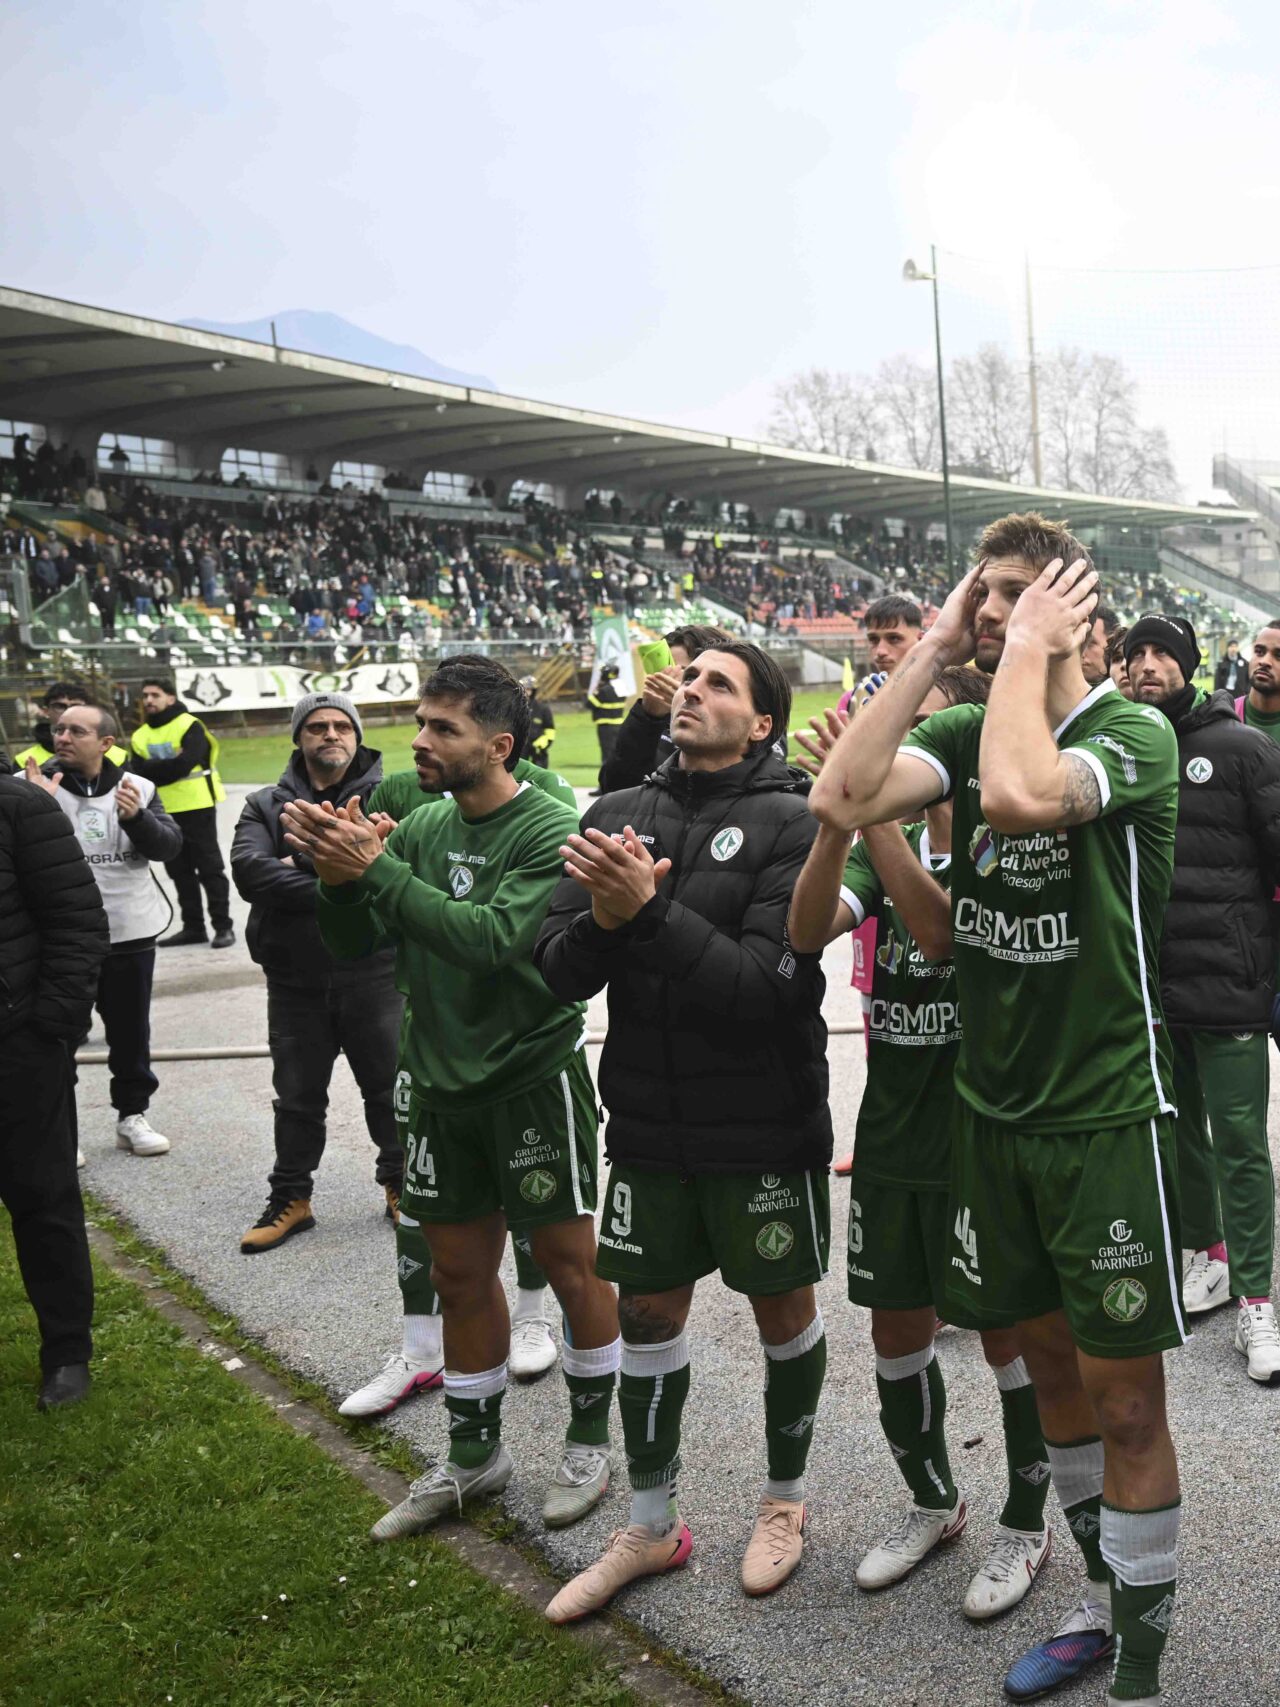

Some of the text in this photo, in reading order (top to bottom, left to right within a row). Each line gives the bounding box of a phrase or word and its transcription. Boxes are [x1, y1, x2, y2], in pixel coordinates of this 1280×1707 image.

[1001, 856, 1019, 871] di
[407, 1132, 436, 1185] 24
[509, 1149, 560, 1169] MARINELLI
[515, 1144, 552, 1158] GRUPPO
[754, 1188, 790, 1202] GRUPPO
[611, 1182, 632, 1237] 9
[748, 1196, 800, 1213] MARINELLI
[848, 1199, 863, 1254] 6
[1098, 1242, 1144, 1258] GRUPPO
[1091, 1250, 1153, 1271] MARINELLI
